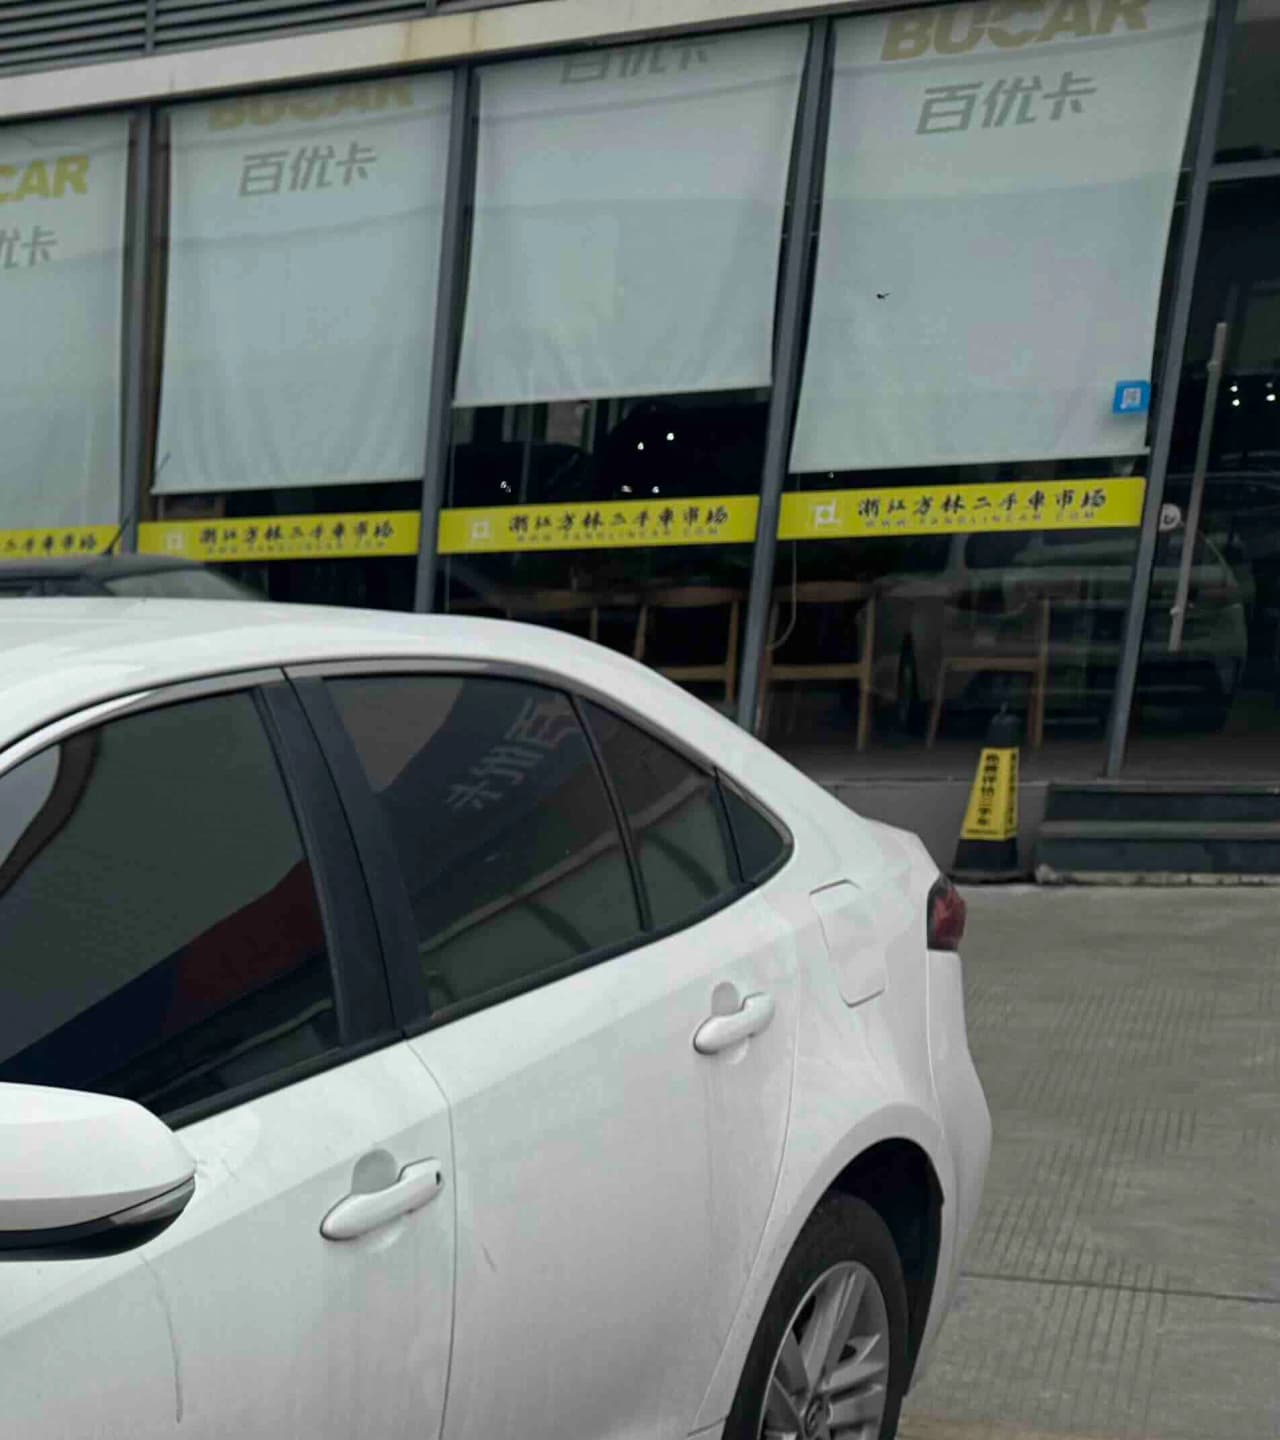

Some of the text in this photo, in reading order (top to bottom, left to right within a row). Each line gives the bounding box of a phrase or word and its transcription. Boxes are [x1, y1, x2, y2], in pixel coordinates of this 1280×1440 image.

[915, 71, 1098, 135] 百优卡
[238, 140, 377, 196] 百优卡
